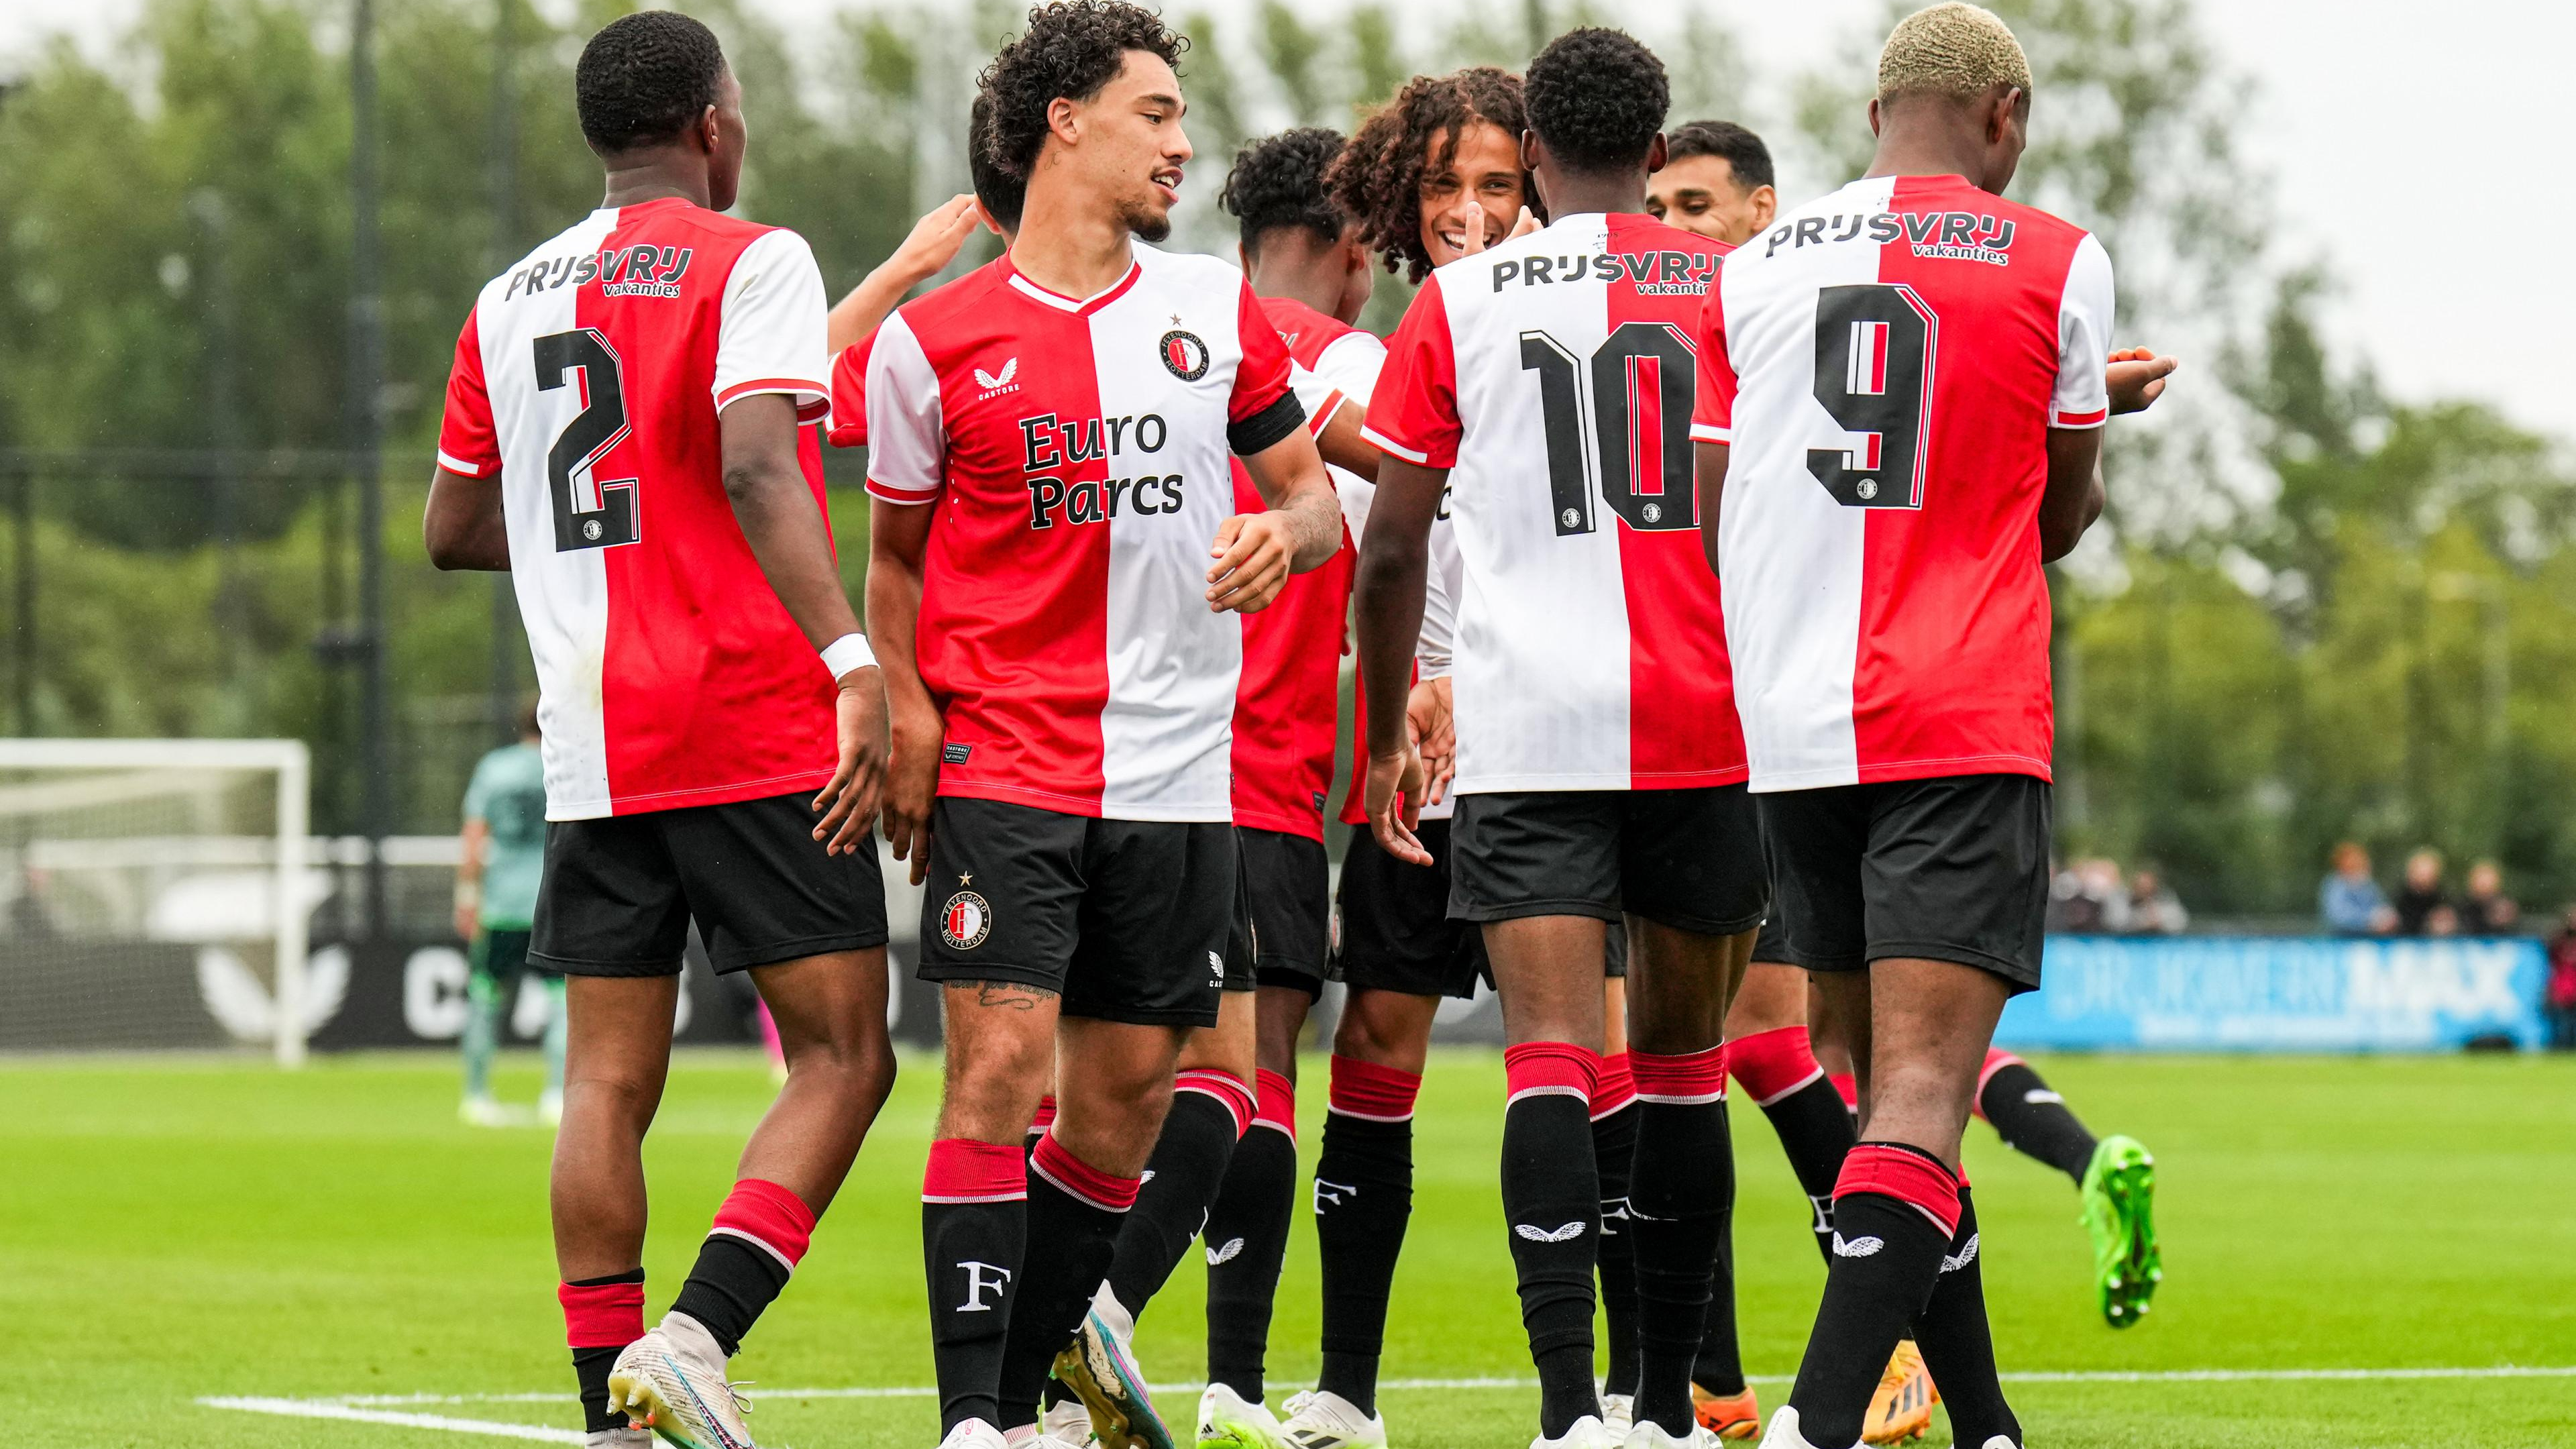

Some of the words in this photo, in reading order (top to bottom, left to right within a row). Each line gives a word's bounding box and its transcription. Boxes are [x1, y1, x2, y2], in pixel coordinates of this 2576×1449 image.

[1911, 242, 2009, 266] vakanties
[602, 280, 681, 298] vakanties
[1161, 331, 1204, 348] FEYENOORD
[1165, 361, 1208, 380] ROTTERDAM
[978, 383, 1020, 401] CASTORE
[1807, 283, 1939, 510] 9
[533, 327, 641, 552] 2
[1018, 412, 1167, 473] Euro
[1519, 321, 1701, 536] 10
[1026, 474, 1183, 530] Parcs
[945, 894, 987, 914] FEYENOORD
[943, 926, 987, 947] ROTTERDAM
[1313, 1177, 1357, 1215] F
[956, 1260, 1011, 1312] F
